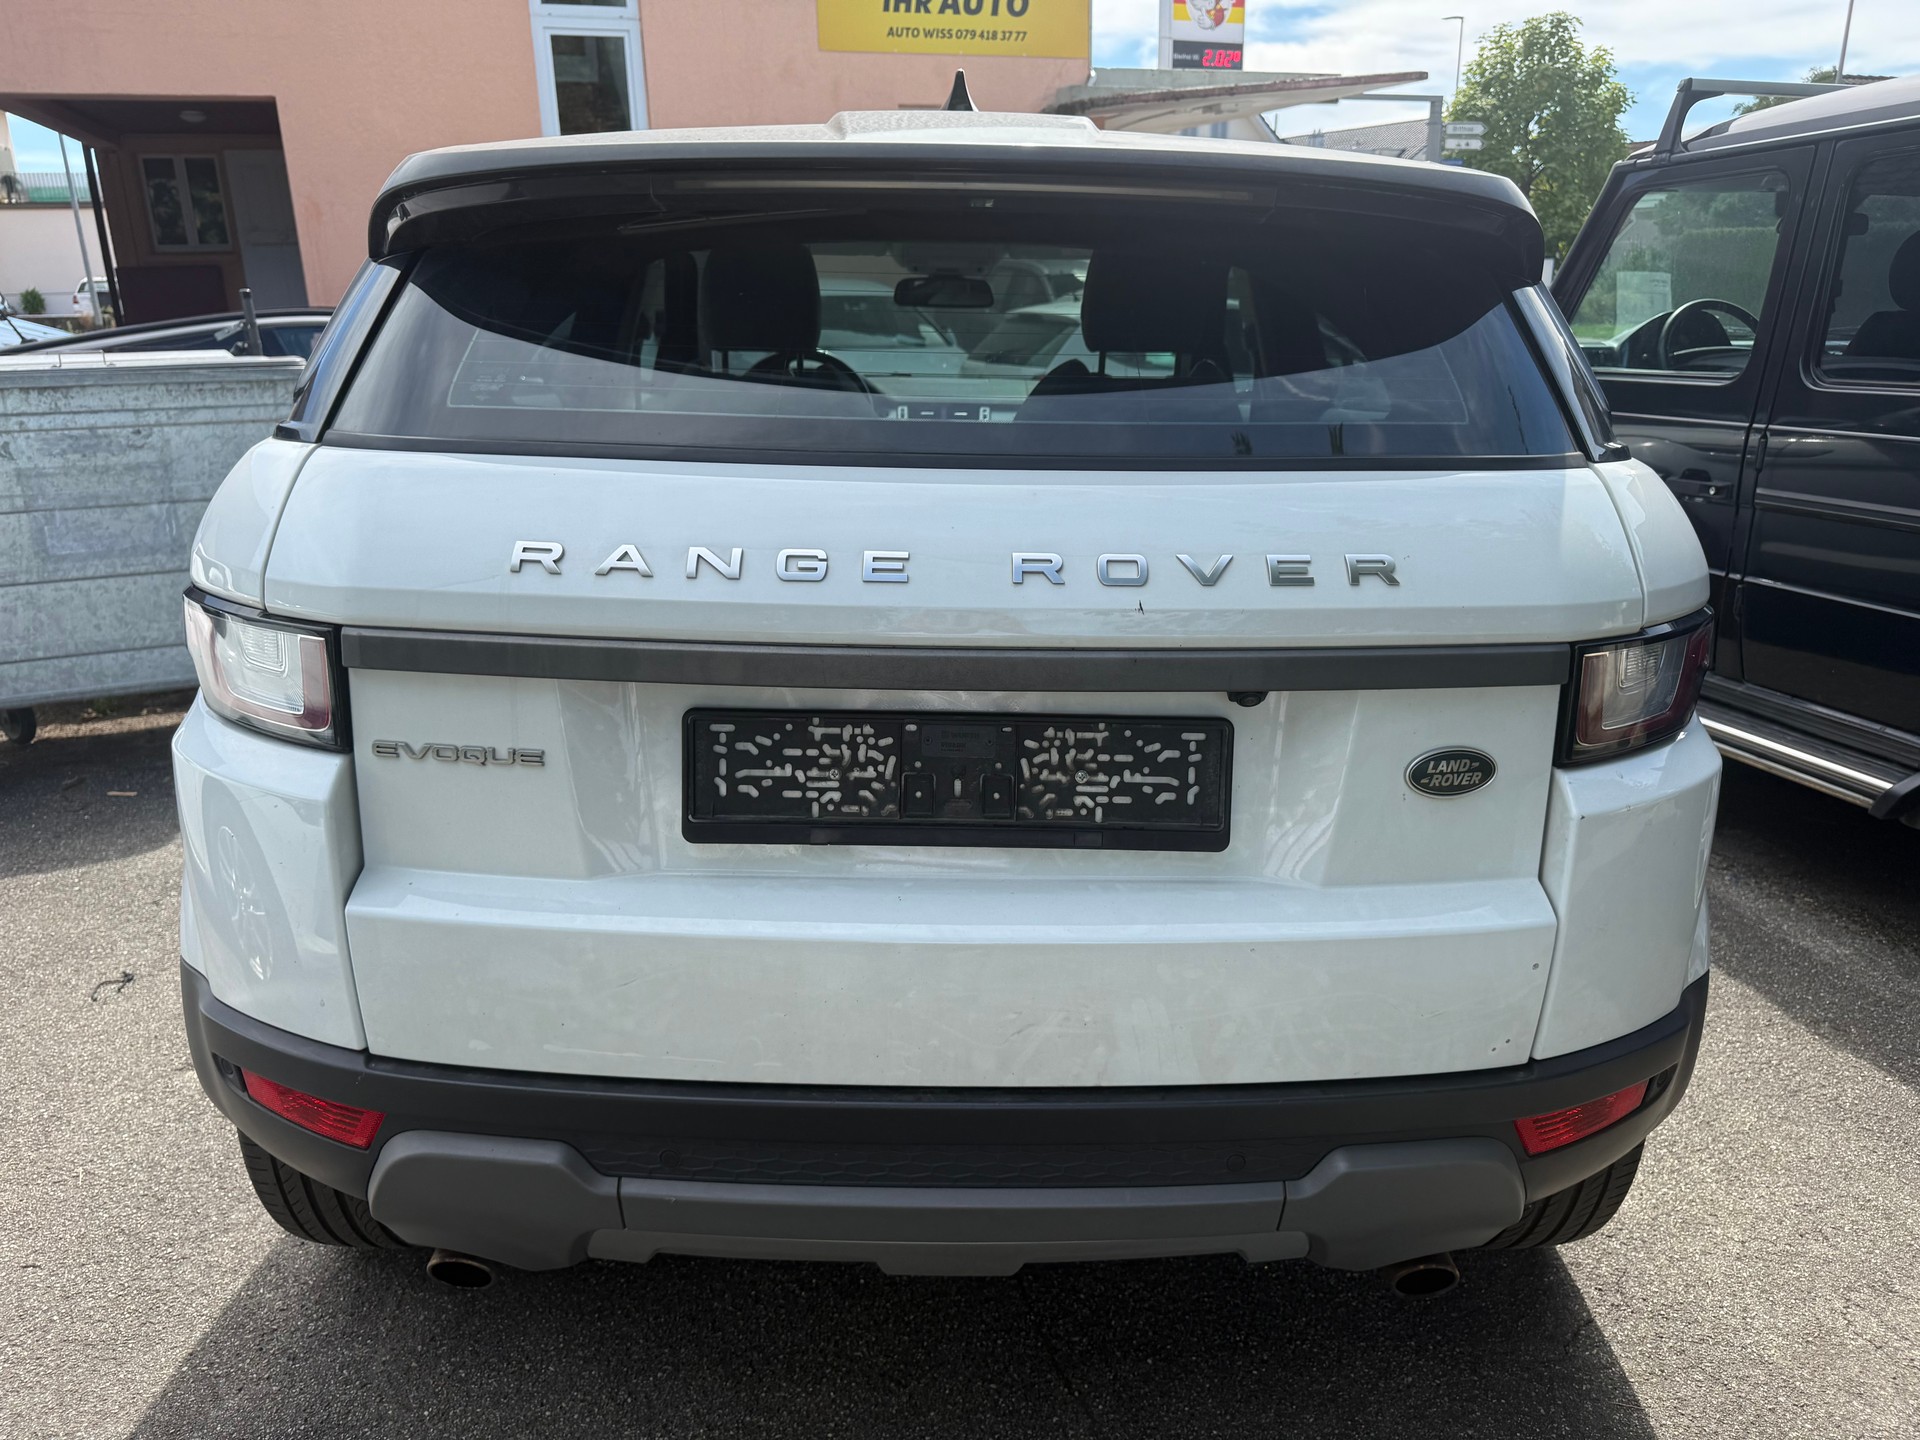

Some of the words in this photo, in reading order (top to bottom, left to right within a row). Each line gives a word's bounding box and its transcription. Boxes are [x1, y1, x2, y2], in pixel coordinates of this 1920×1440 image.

[937, 0, 1029, 17] AUTO
[887, 26, 920, 38] AUTO
[922, 27, 953, 39] WISS
[955, 29, 976, 40] 079
[978, 30, 998, 41] 418
[1000, 31, 1013, 41] 37
[1014, 31, 1028, 42] 77
[510, 540, 910, 583] RANGE
[1011, 552, 1401, 586] ROVER
[372, 739, 545, 766] EVOQUE
